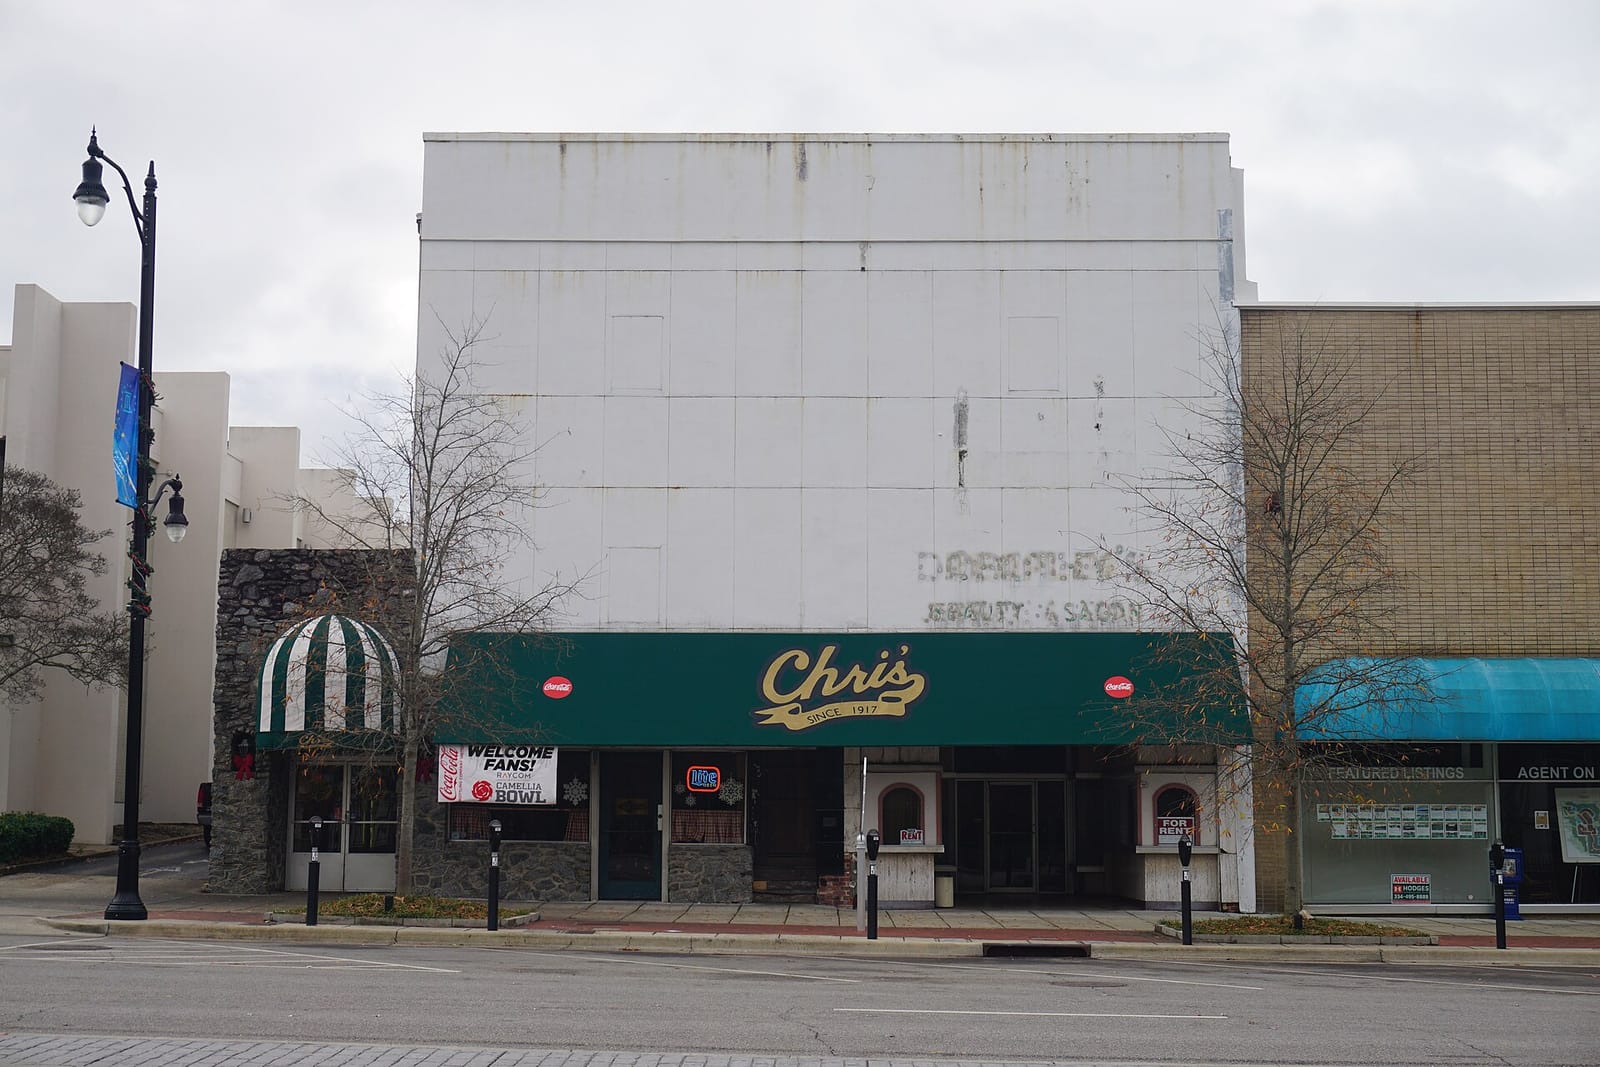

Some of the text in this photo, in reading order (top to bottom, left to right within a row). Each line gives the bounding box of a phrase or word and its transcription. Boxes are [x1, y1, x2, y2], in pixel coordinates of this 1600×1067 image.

[806, 705, 878, 725] SINCE 1917
[467, 745, 555, 759] WELCOME
[483, 758, 537, 771] FANS!
[691, 770, 718, 786] Lite
[1328, 767, 1465, 780] FEATURED LISTINGS
[1517, 766, 1595, 779] AGENT ON
[496, 782, 542, 790] CAMELLIA
[495, 790, 547, 804] BOWL
[1163, 819, 1187, 827] FOR
[902, 830, 922, 841] RENT
[1159, 827, 1192, 835] RENT
